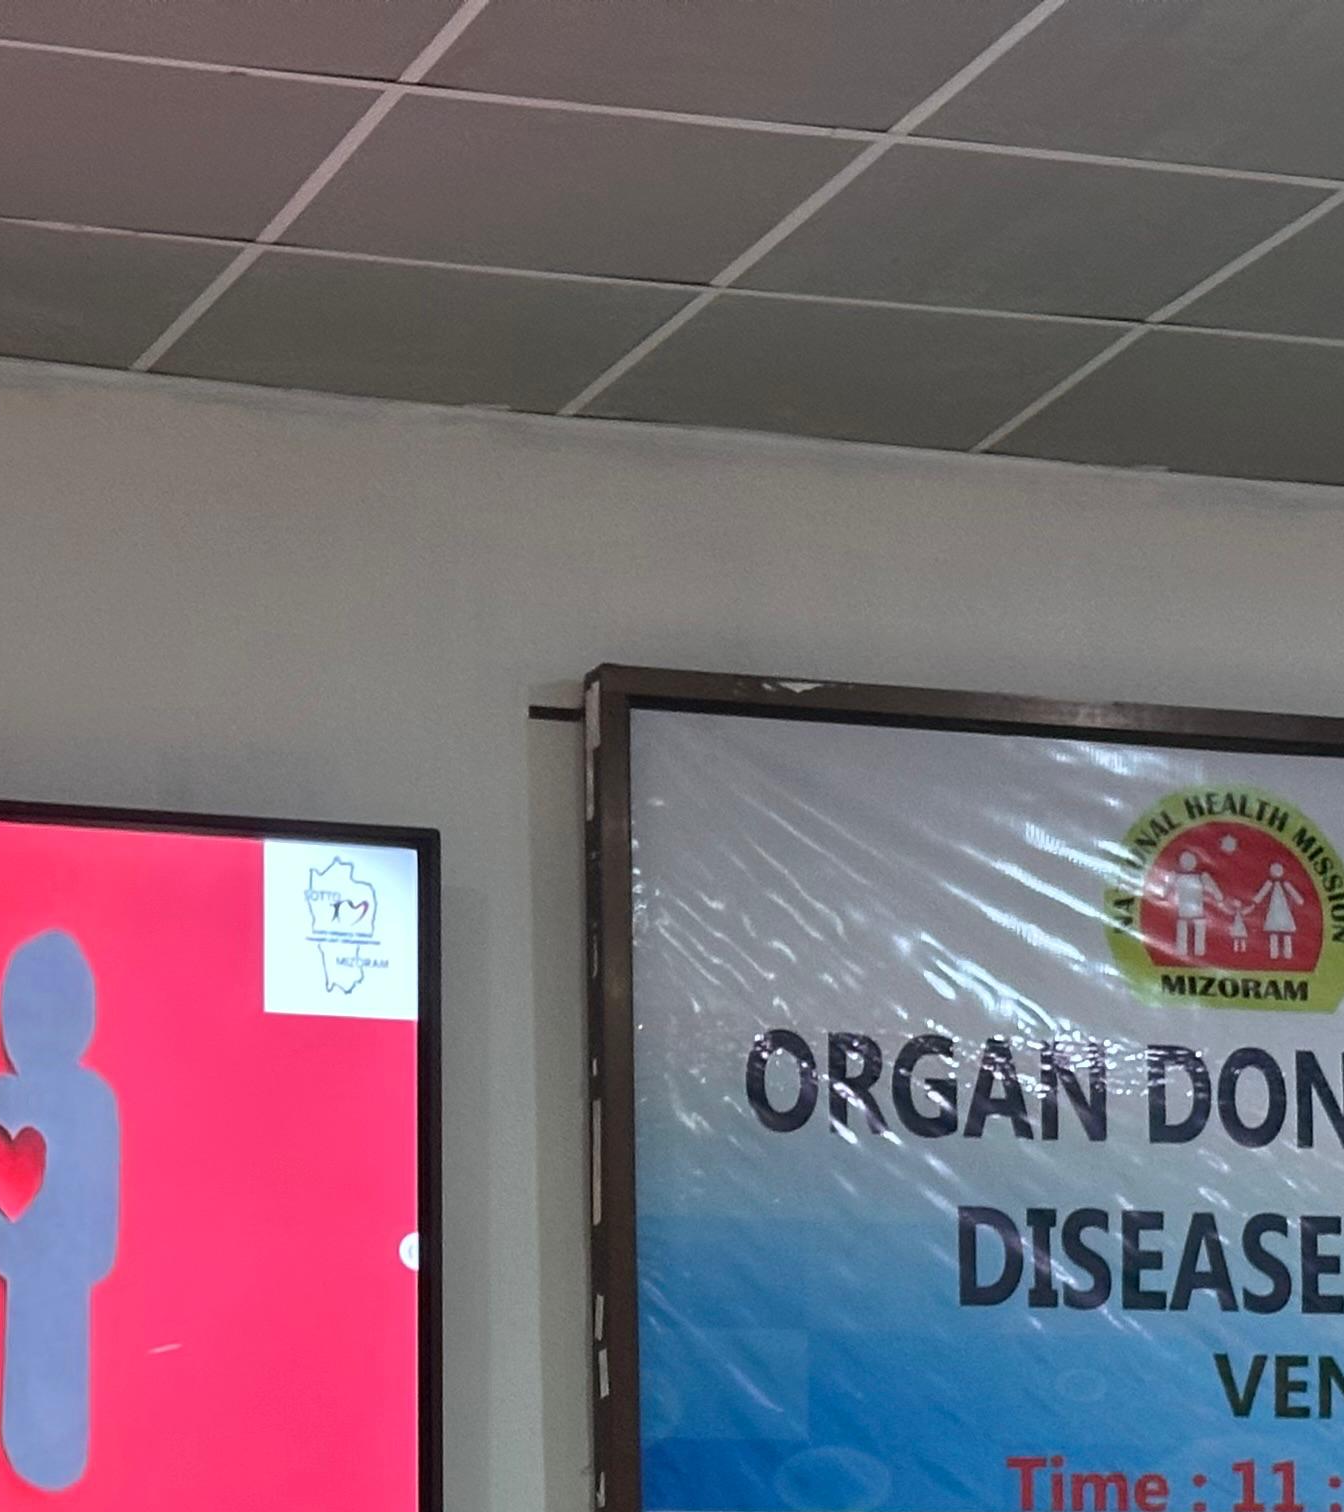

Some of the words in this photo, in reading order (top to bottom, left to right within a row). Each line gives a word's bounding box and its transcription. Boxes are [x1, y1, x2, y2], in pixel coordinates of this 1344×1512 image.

[1113, 811, 1182, 934] NAONAL
[1183, 792, 1289, 832] HEALTH
[1160, 974, 1309, 1002] MIZORAM
[745, 1029, 1109, 1143] ORGAN
